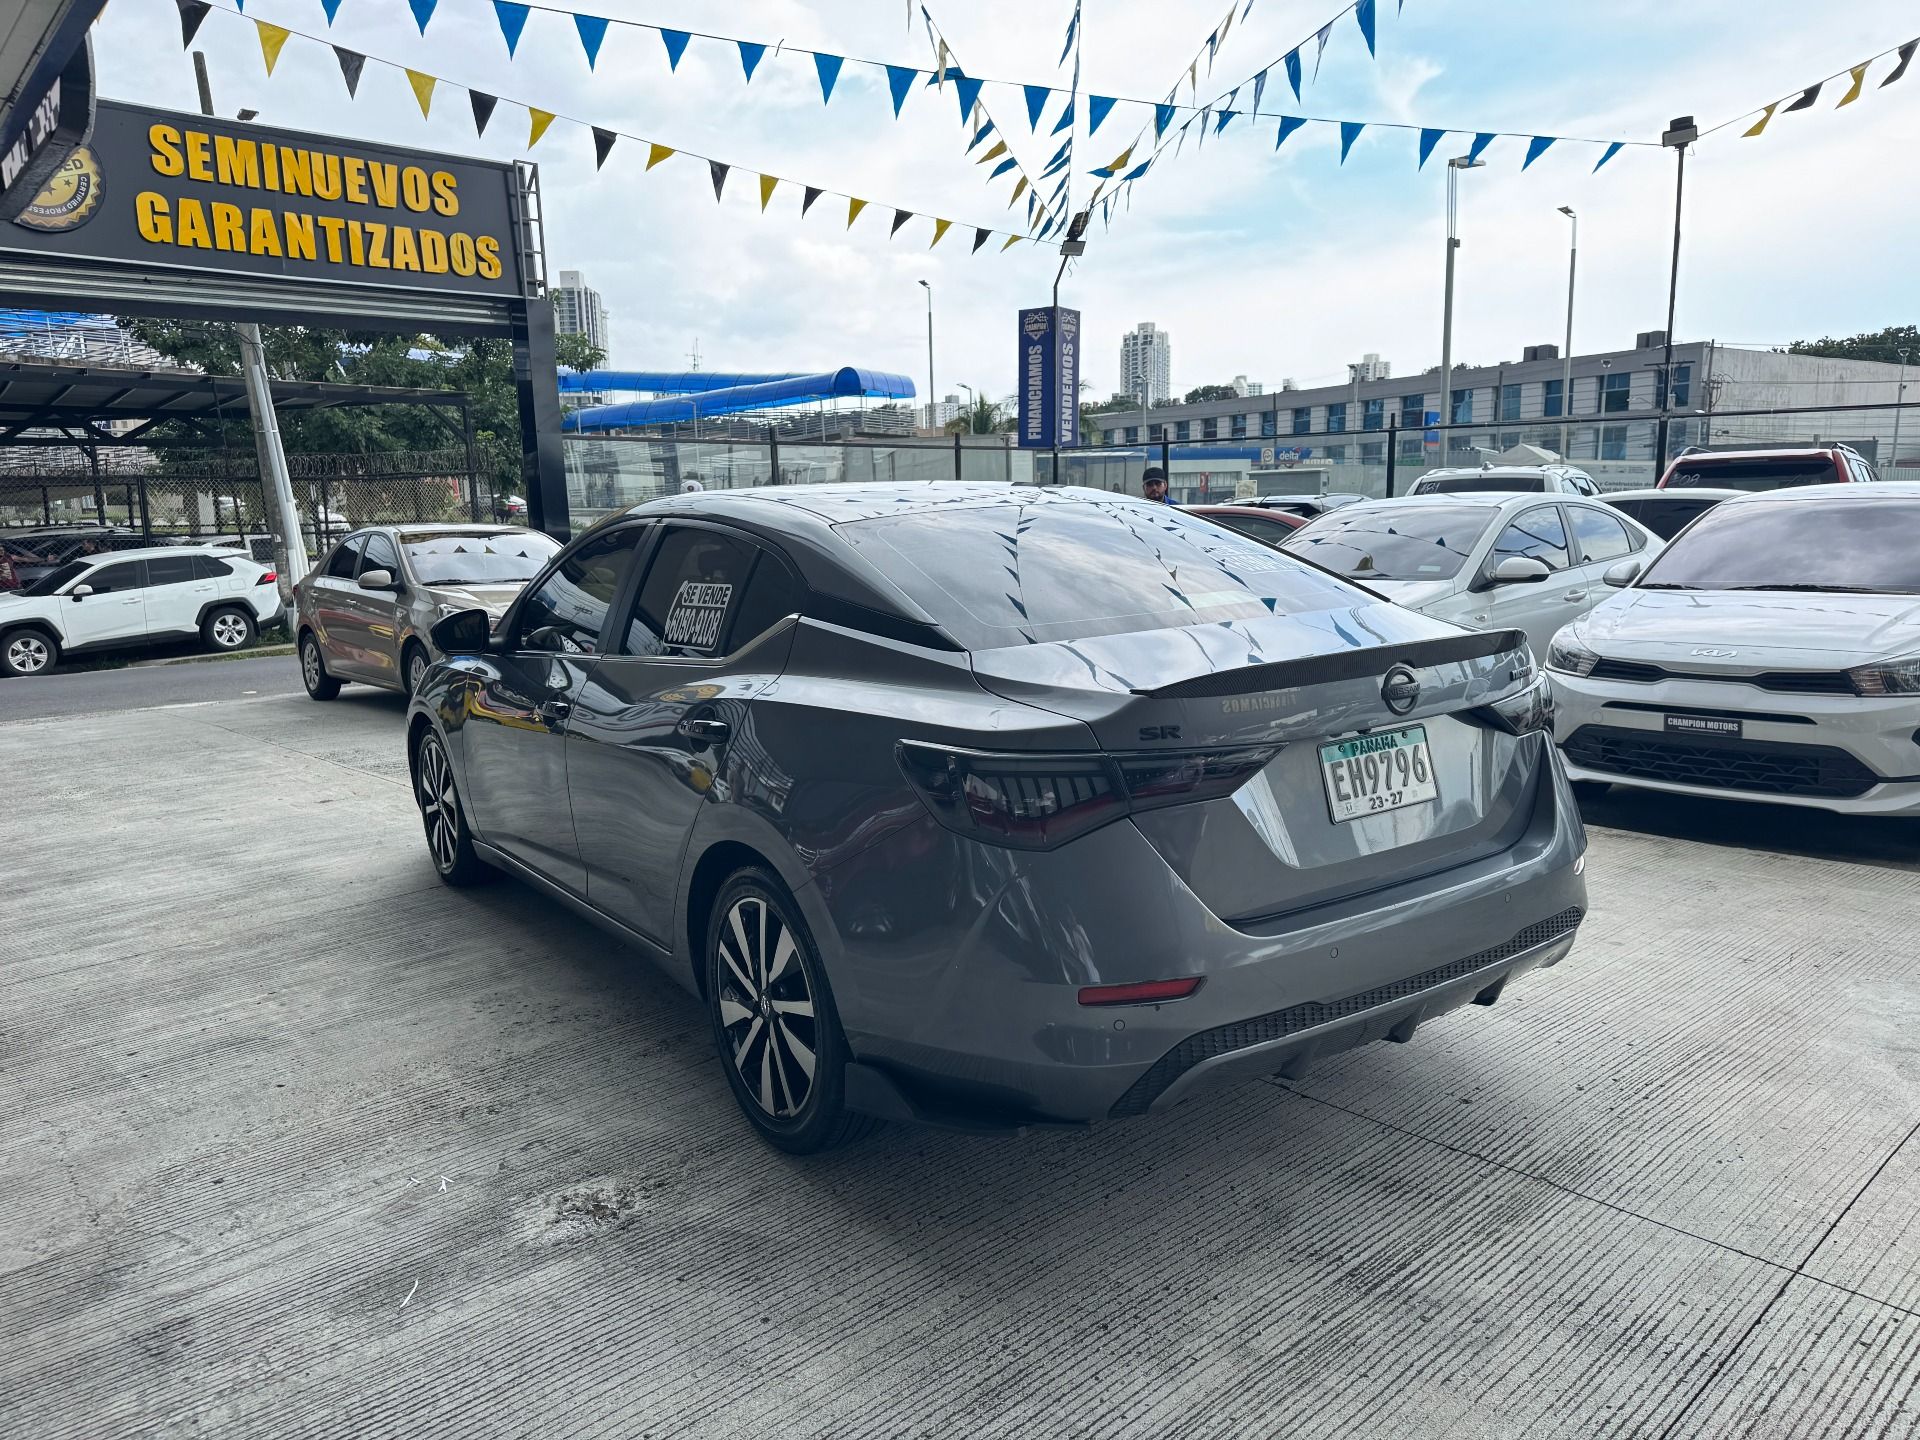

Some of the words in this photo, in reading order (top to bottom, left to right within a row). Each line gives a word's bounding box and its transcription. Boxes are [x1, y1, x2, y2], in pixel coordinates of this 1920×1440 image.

[148, 123, 460, 217] SEMINUEVOS
[66, 176, 88, 209] CERTIFIED
[135, 191, 502, 280] GARANTIZADOS
[1028, 344, 1043, 440] FINANCIAMOS
[1061, 342, 1074, 443] VENDEMOS
[1279, 451, 1299, 461] delta
[684, 585, 698, 604] SE
[698, 586, 730, 605] VENDE
[668, 607, 721, 645] 6050-9108
[1690, 648, 1738, 659] KIA
[1388, 682, 1420, 697] NISSAN
[1139, 725, 1182, 741] SR
[1667, 717, 1706, 729] CHAMPION
[1706, 721, 1739, 731] MOTORS
[1353, 735, 1398, 757] PANAMA
[1330, 744, 1428, 802] EH9796
